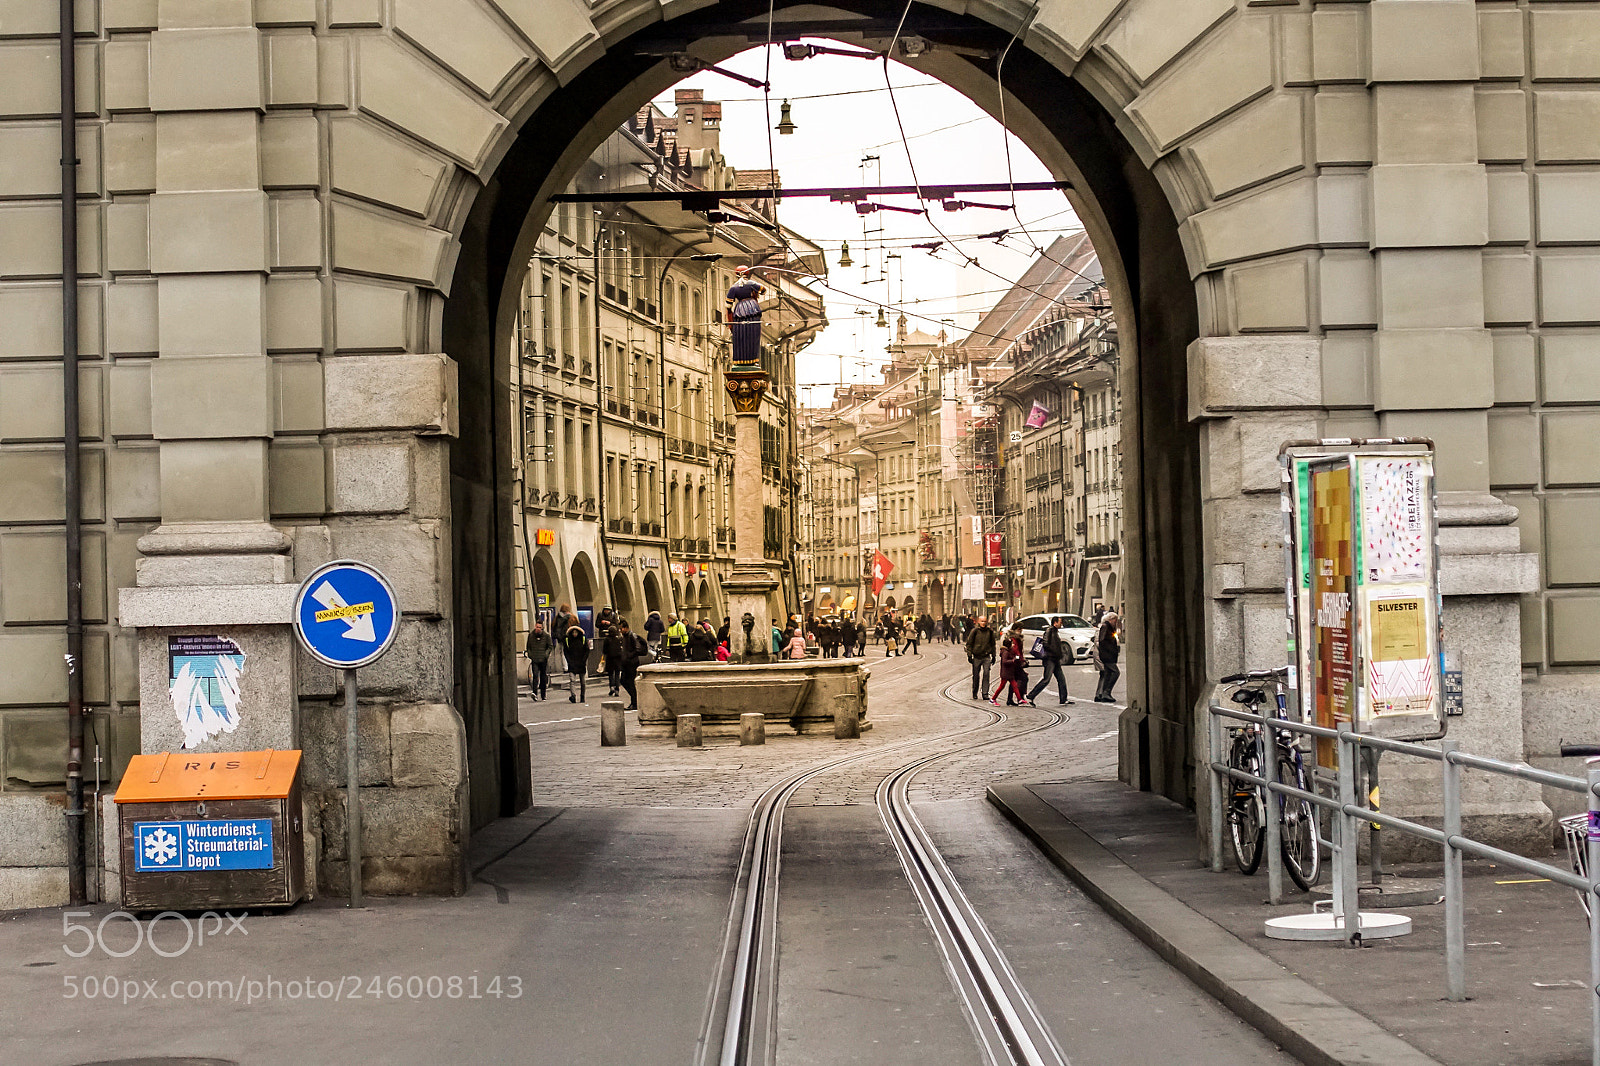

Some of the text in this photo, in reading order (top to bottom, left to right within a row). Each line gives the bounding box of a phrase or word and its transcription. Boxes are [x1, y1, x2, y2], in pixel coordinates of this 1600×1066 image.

[1377, 602, 1418, 612] SILVESTER
[186, 822, 258, 838] Winterdienst
[187, 837, 269, 853] Streumaterial-
[188, 853, 221, 870] Depot
